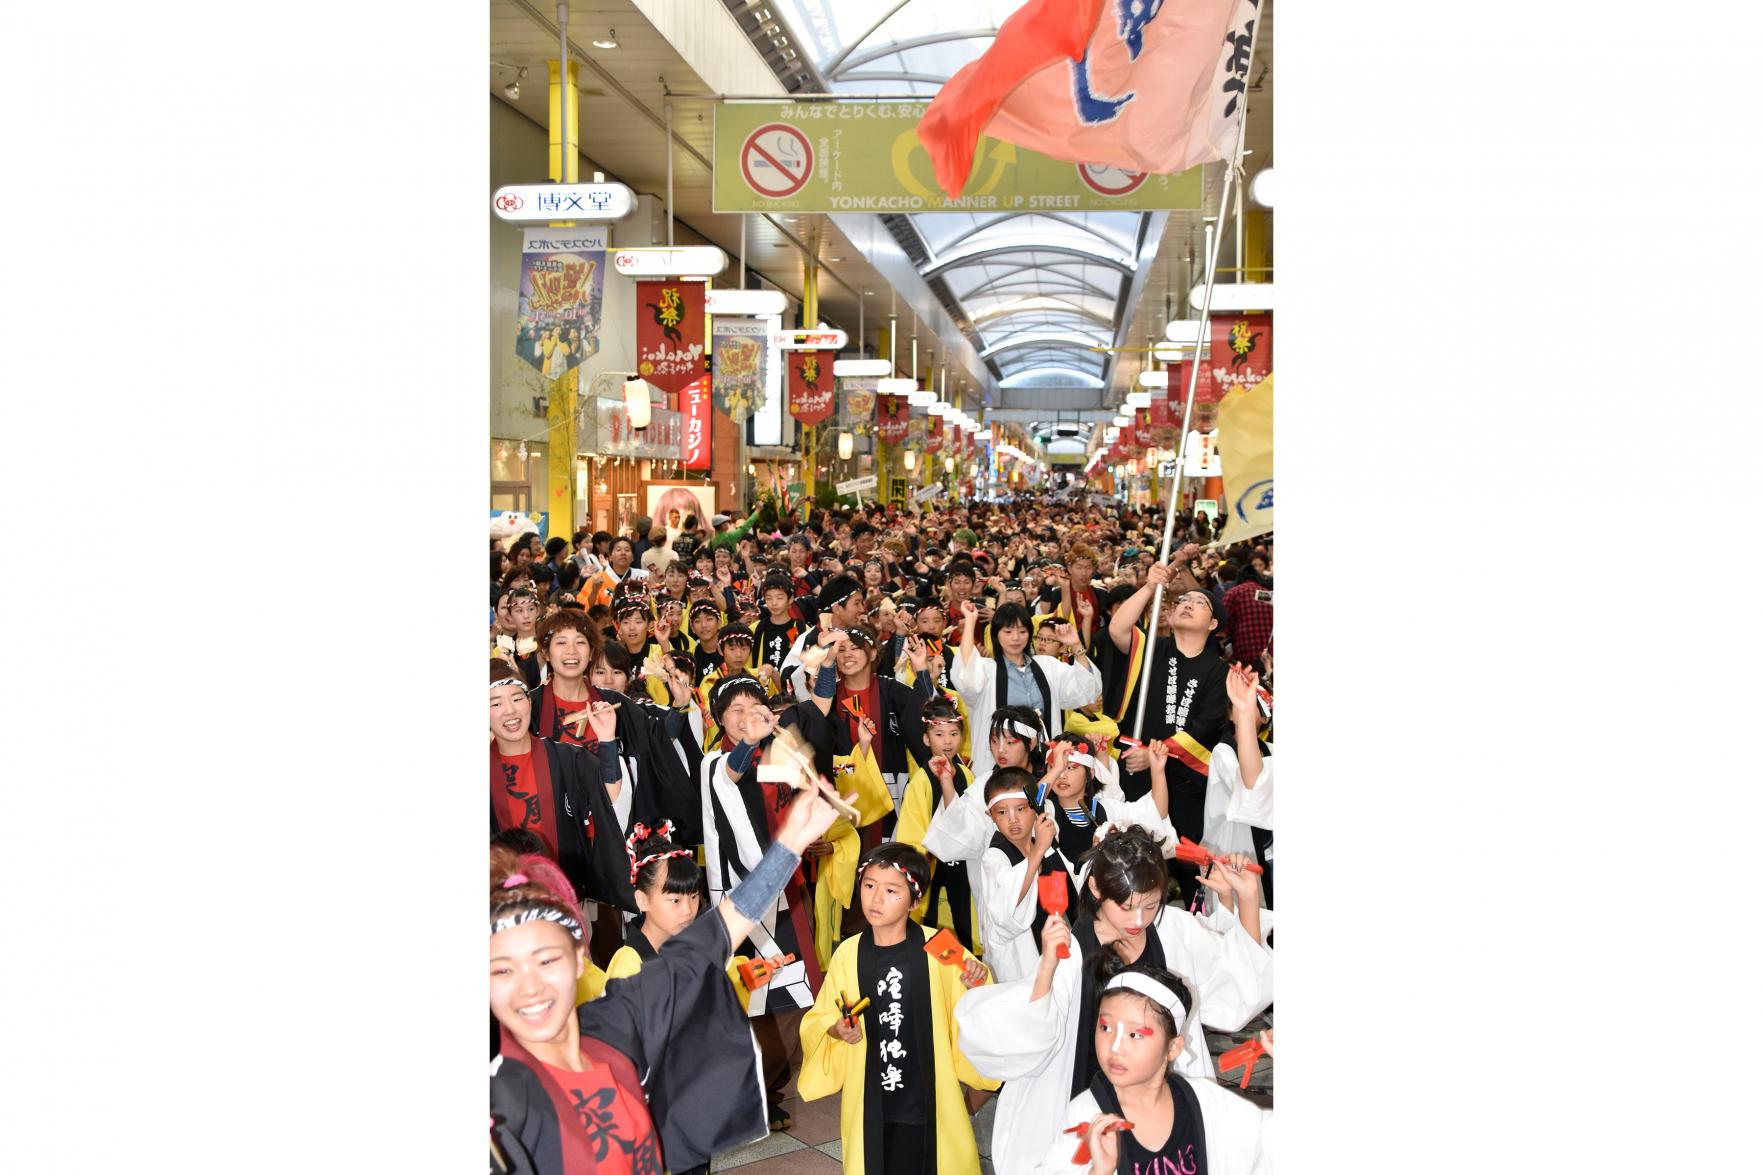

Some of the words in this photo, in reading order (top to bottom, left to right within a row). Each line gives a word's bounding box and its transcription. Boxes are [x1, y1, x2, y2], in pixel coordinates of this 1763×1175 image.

[538, 192, 613, 211] 博文堂
[829, 196, 923, 209] YONKACHO
[927, 196, 998, 209] MANNER
[1003, 196, 1024, 209] UP
[1028, 195, 1081, 208] STREET
[1231, 320, 1252, 354] 祝祭
[683, 381, 701, 465] ニューカジノ
[877, 966, 907, 1092] 喧嘩独楽
